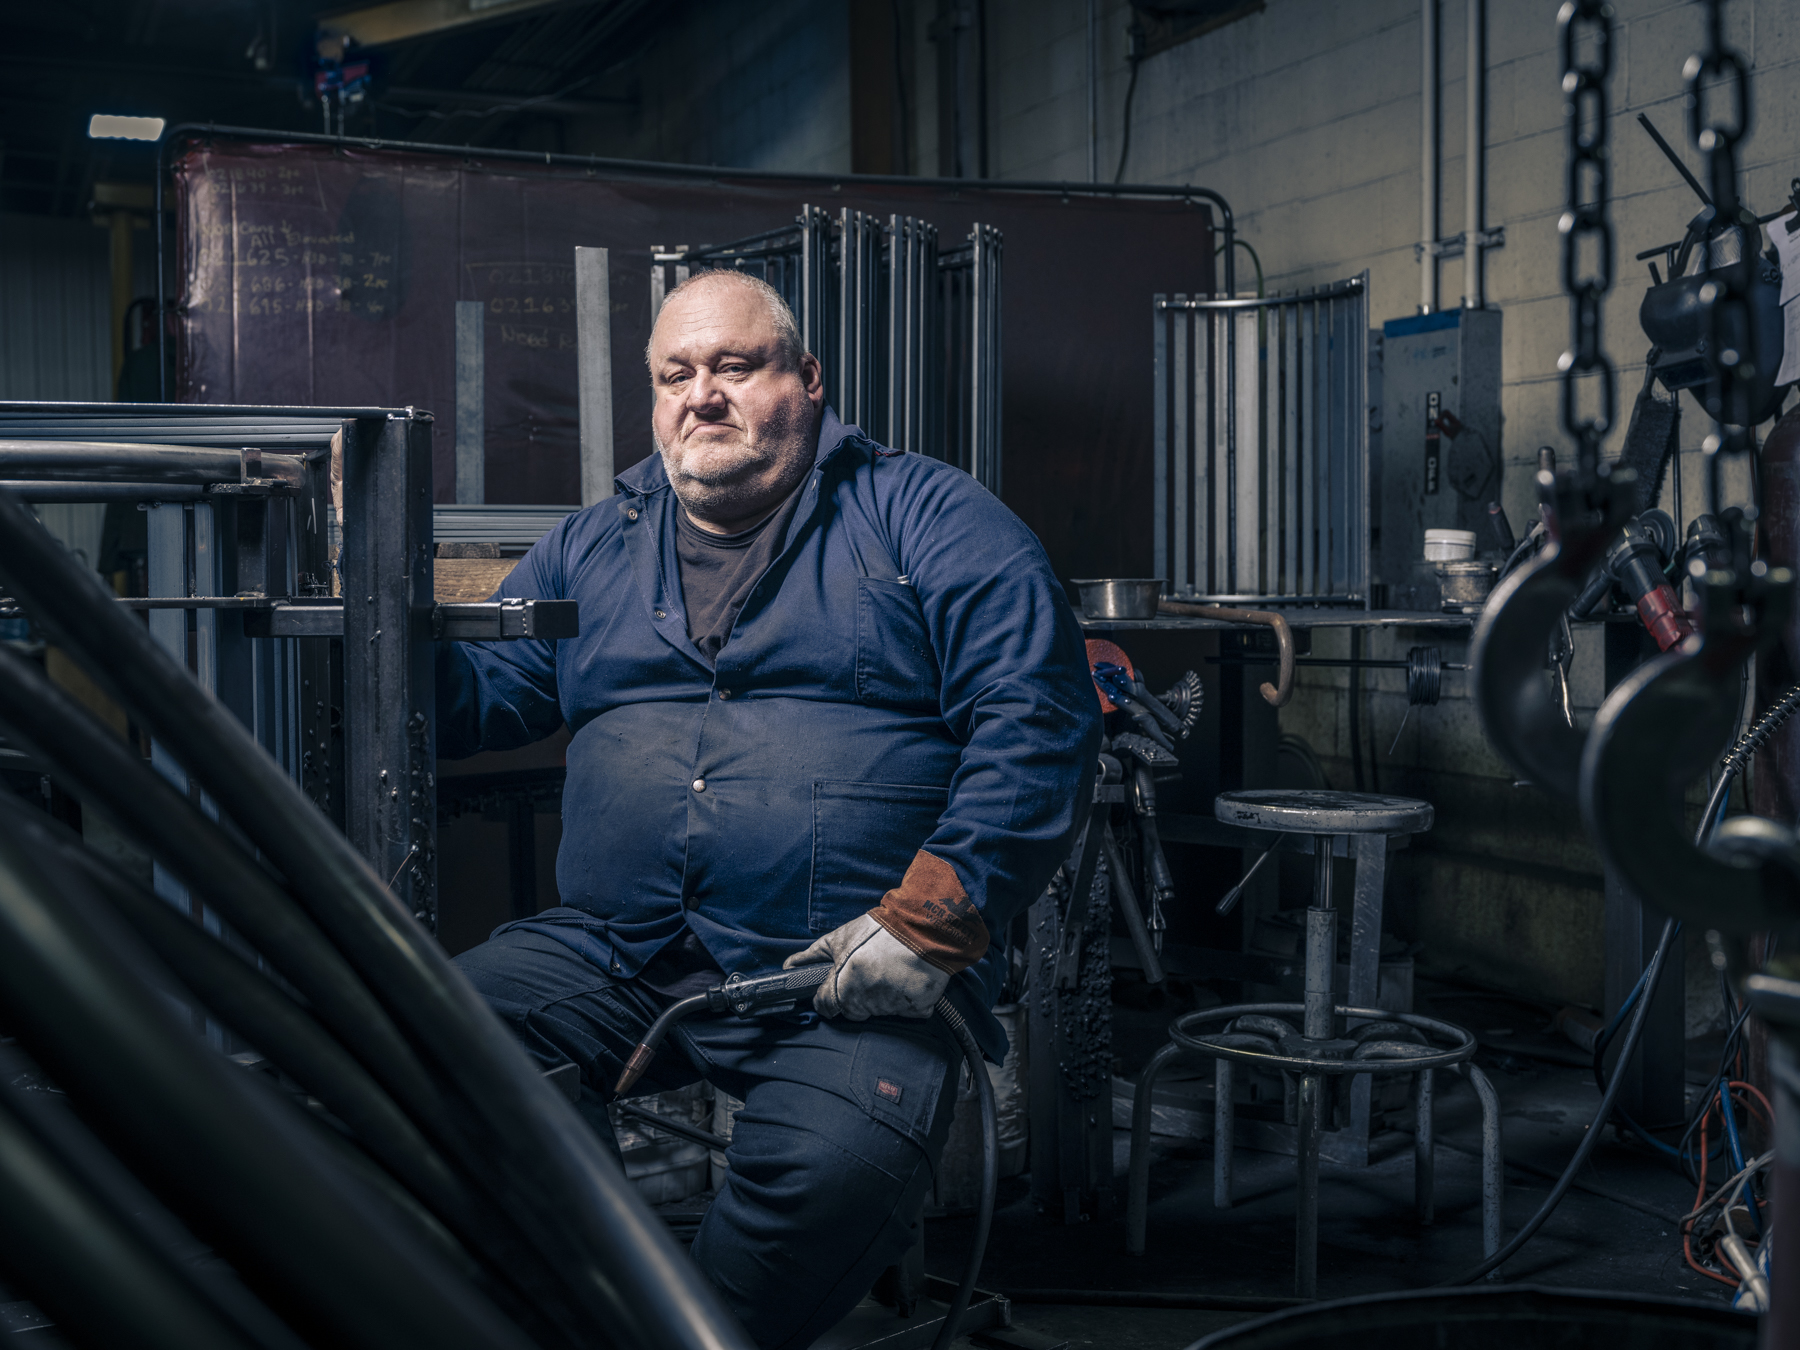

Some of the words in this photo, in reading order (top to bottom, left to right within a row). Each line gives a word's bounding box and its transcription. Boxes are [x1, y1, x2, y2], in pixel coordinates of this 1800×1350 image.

[922, 899, 947, 919] MCR
[944, 913, 979, 942] SAFETY
[925, 912, 969, 946] WELDING
